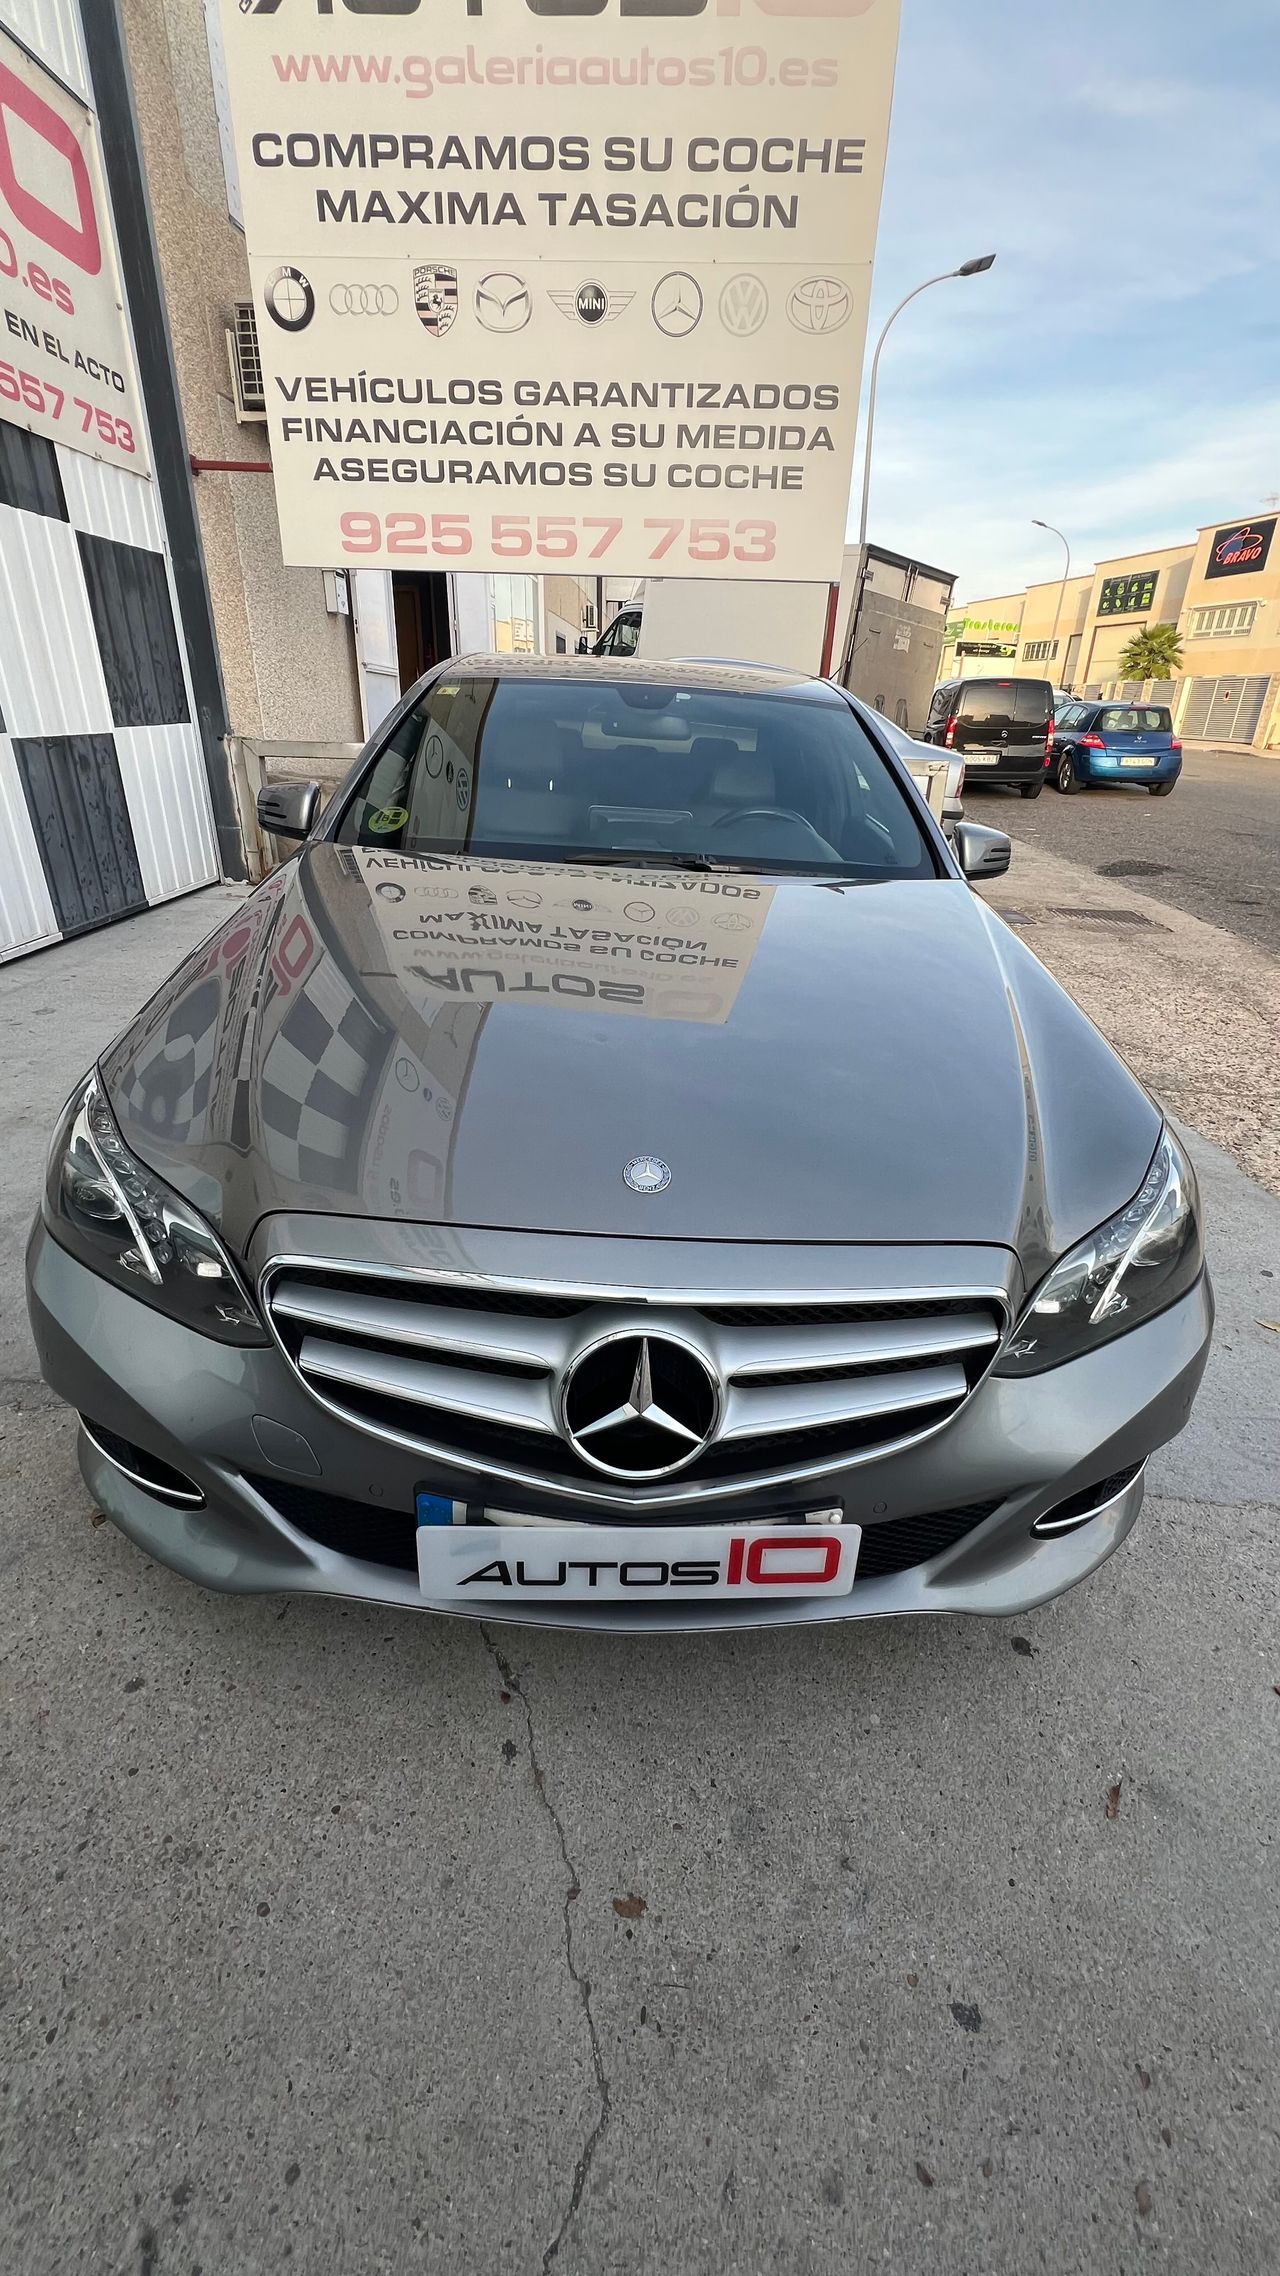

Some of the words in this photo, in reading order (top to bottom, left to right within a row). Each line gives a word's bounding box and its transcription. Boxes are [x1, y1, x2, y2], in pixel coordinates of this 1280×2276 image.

[272, 44, 840, 99] www.galeriaautos10.es
[251, 132, 590, 172] COMPRAMOS
[604, 136, 673, 172] SU
[687, 138, 866, 174] COCHE
[316, 189, 527, 226] MAXIMA
[538, 184, 799, 229] TASACIÓN
[578, 297, 605, 311] MINI
[4, 308, 39, 351] EN
[43, 329, 70, 365] EL
[74, 349, 126, 394] ACTO
[274, 371, 503, 406] VEHÍCULOS
[513, 380, 840, 411] GARANTIZADOS
[73, 397, 136, 454] 753
[282, 414, 563, 447] FINANCIACIÓN
[574, 423, 601, 448] A
[611, 423, 665, 449] SU
[676, 424, 835, 452] MEDIDA
[313, 457, 593, 487] ASEGURAMOS
[603, 462, 657, 488] SU
[667, 463, 804, 490] COCHE
[340, 511, 473, 556] 925
[490, 515, 623, 559] 557
[643, 518, 777, 562] 753
[1222, 546, 1262, 565] BRAVO
[456, 1535, 843, 1587] AUTOS10
